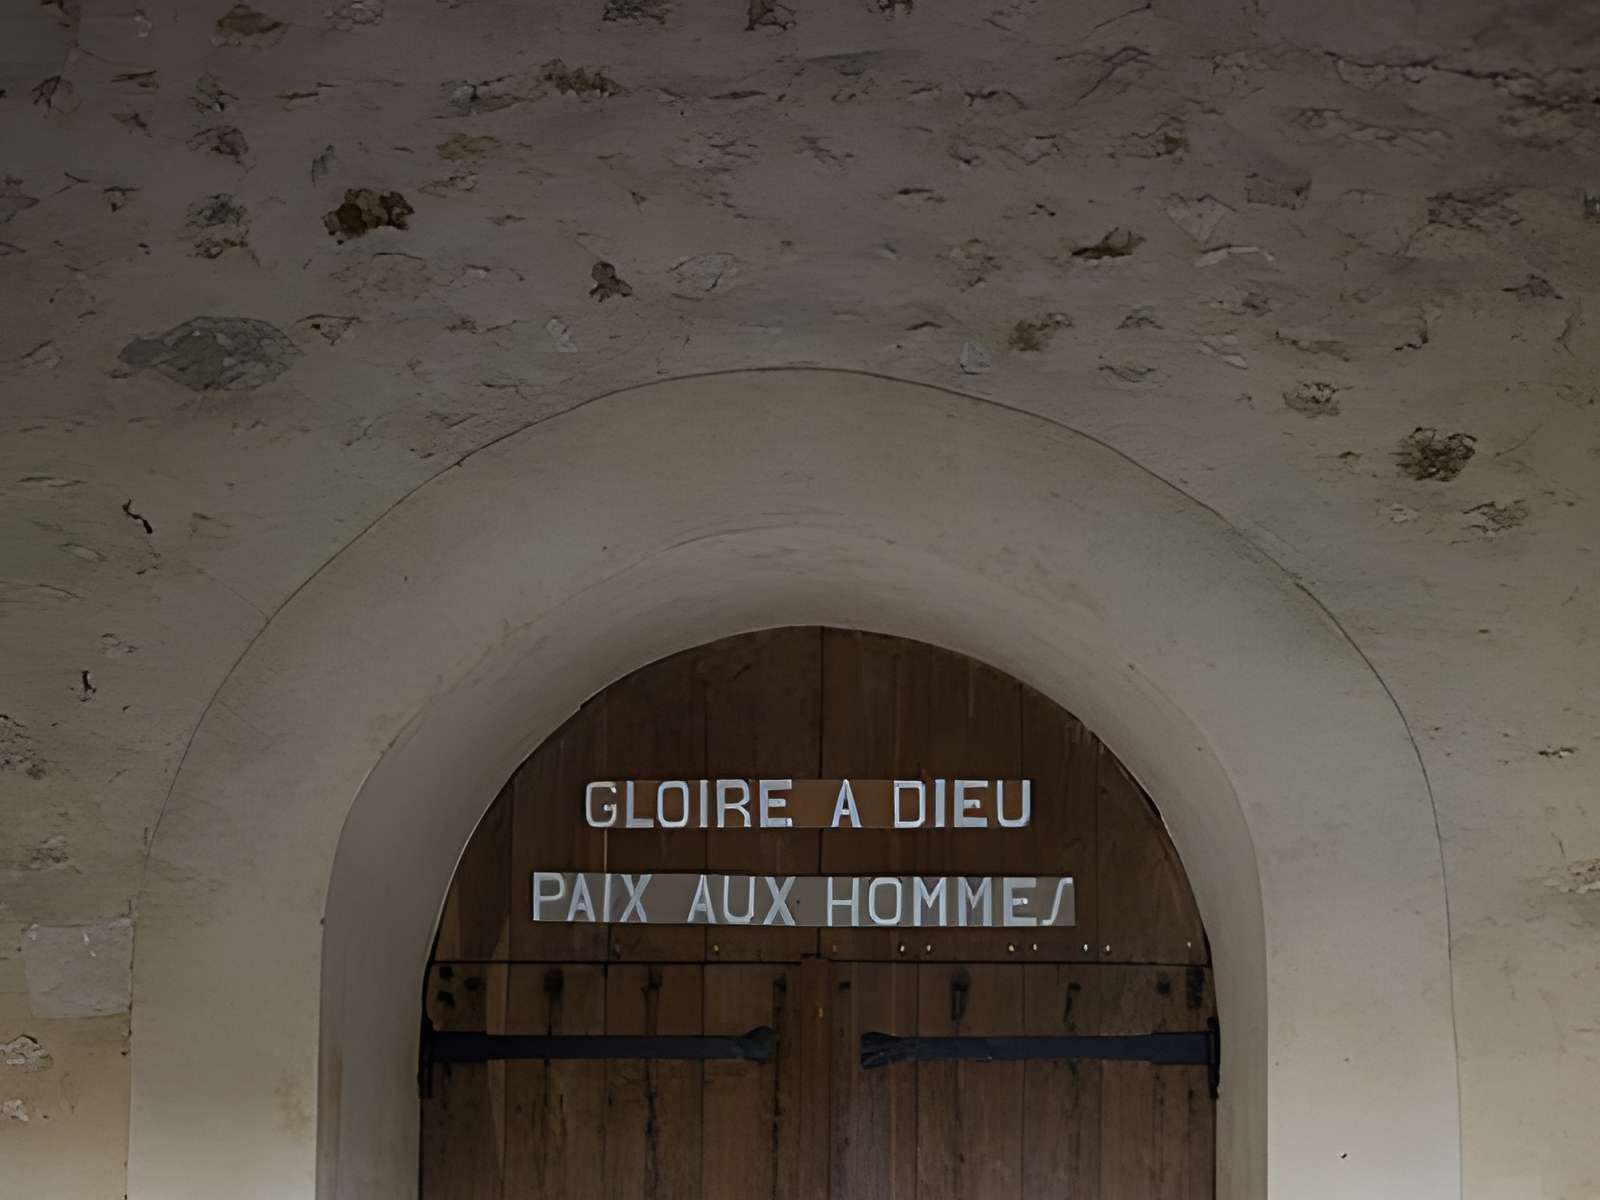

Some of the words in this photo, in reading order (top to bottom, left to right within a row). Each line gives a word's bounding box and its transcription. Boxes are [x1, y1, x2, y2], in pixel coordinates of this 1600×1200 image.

[585, 779, 794, 829] GLOIRE
[831, 778, 863, 829] A
[893, 779, 1032, 829] DIEU
[533, 872, 652, 923] PAIX
[687, 874, 797, 926] AUX
[827, 876, 1075, 927] HOMMES
